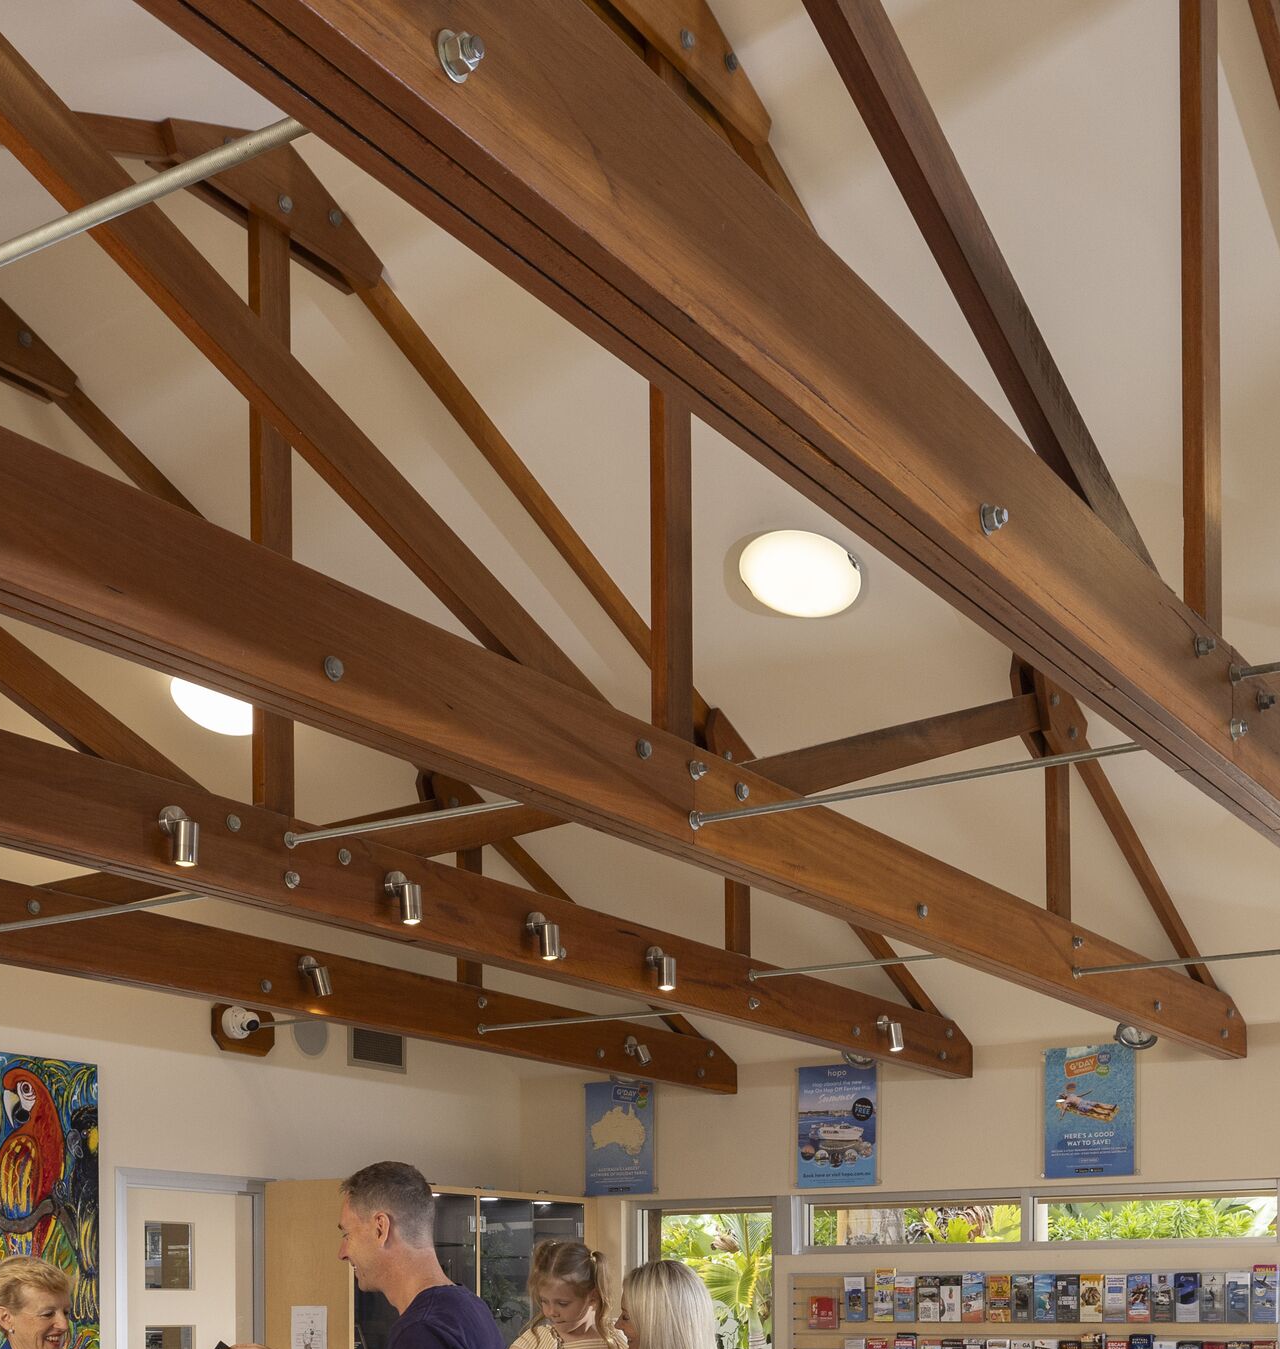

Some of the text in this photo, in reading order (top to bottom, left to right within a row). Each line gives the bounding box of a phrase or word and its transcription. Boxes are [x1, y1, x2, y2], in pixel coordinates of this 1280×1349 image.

[1069, 1059, 1095, 1070] G'DAY
[827, 1069, 847, 1077] hopo
[616, 1089, 637, 1097] G'DAY
[855, 1107, 871, 1115] FREE
[1064, 1132, 1087, 1140] HERE'S
